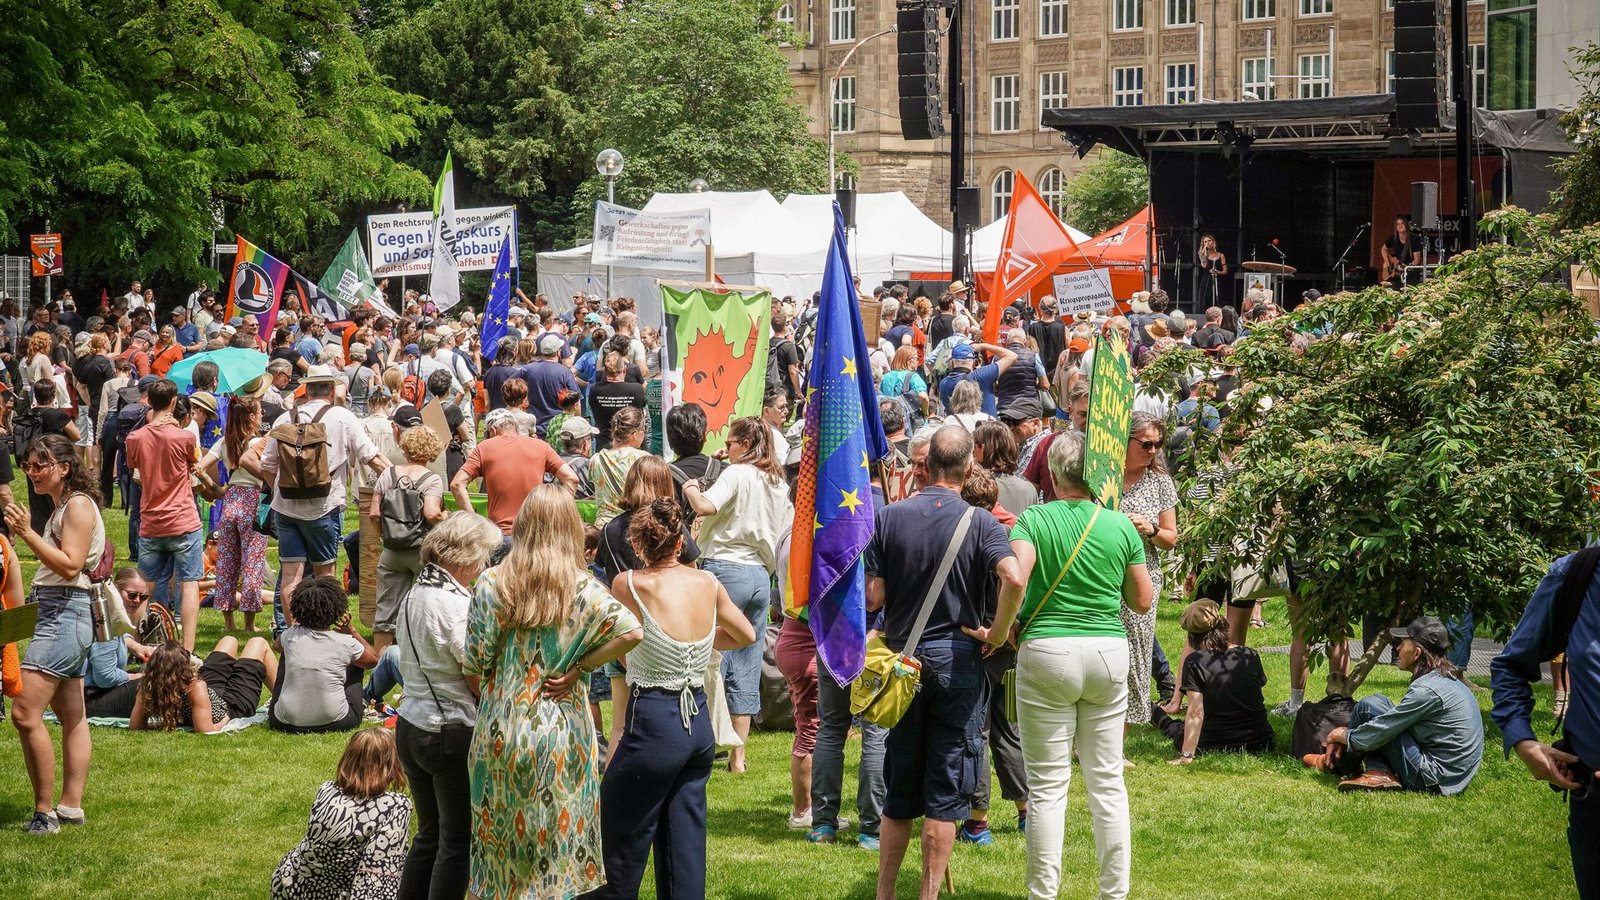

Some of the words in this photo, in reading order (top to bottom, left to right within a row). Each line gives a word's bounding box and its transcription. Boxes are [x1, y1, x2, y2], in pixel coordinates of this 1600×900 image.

[371, 221, 391, 229] Dem
[393, 219, 433, 228] Rechtsru
[456, 216, 481, 225] gegen
[618, 219, 671, 231] Gewerkschaften
[377, 232, 423, 248] Gegen
[383, 247, 409, 263] und
[374, 262, 432, 274] Kapitalismus
[1064, 274, 1090, 284] Bildung
[1073, 281, 1093, 290] sozial
[1073, 303, 1092, 311] extrem
[1094, 300, 1111, 308] rechts
